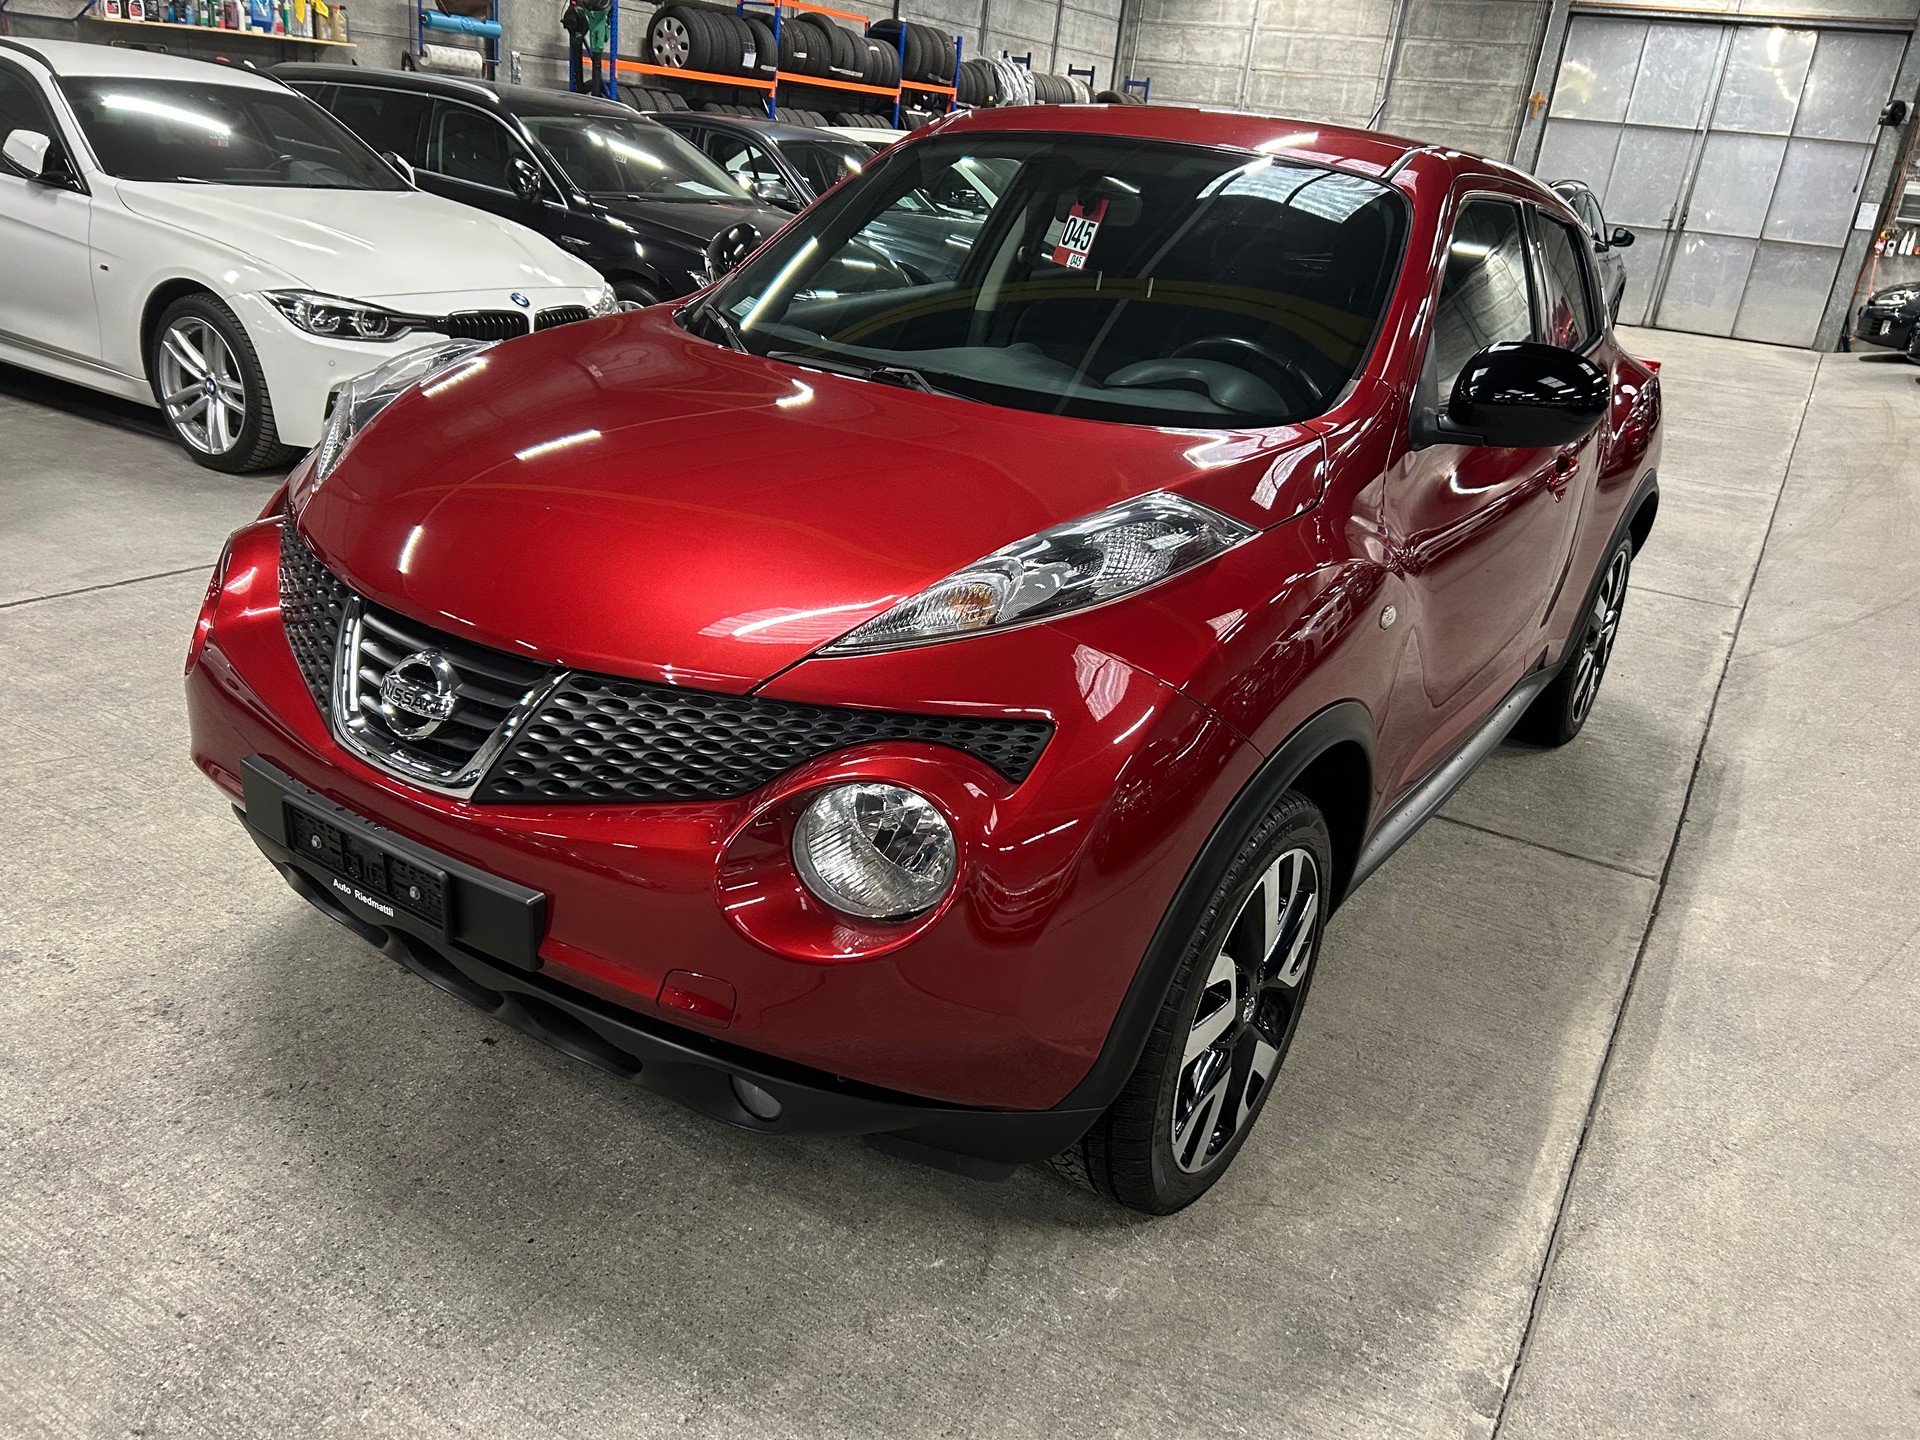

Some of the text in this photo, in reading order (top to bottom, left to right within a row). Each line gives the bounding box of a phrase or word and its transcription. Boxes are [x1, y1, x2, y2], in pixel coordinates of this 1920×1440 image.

[1061, 217, 1096, 250] 045
[1070, 255, 1082, 267] 045
[333, 878, 394, 918] Auto Riedmattli
